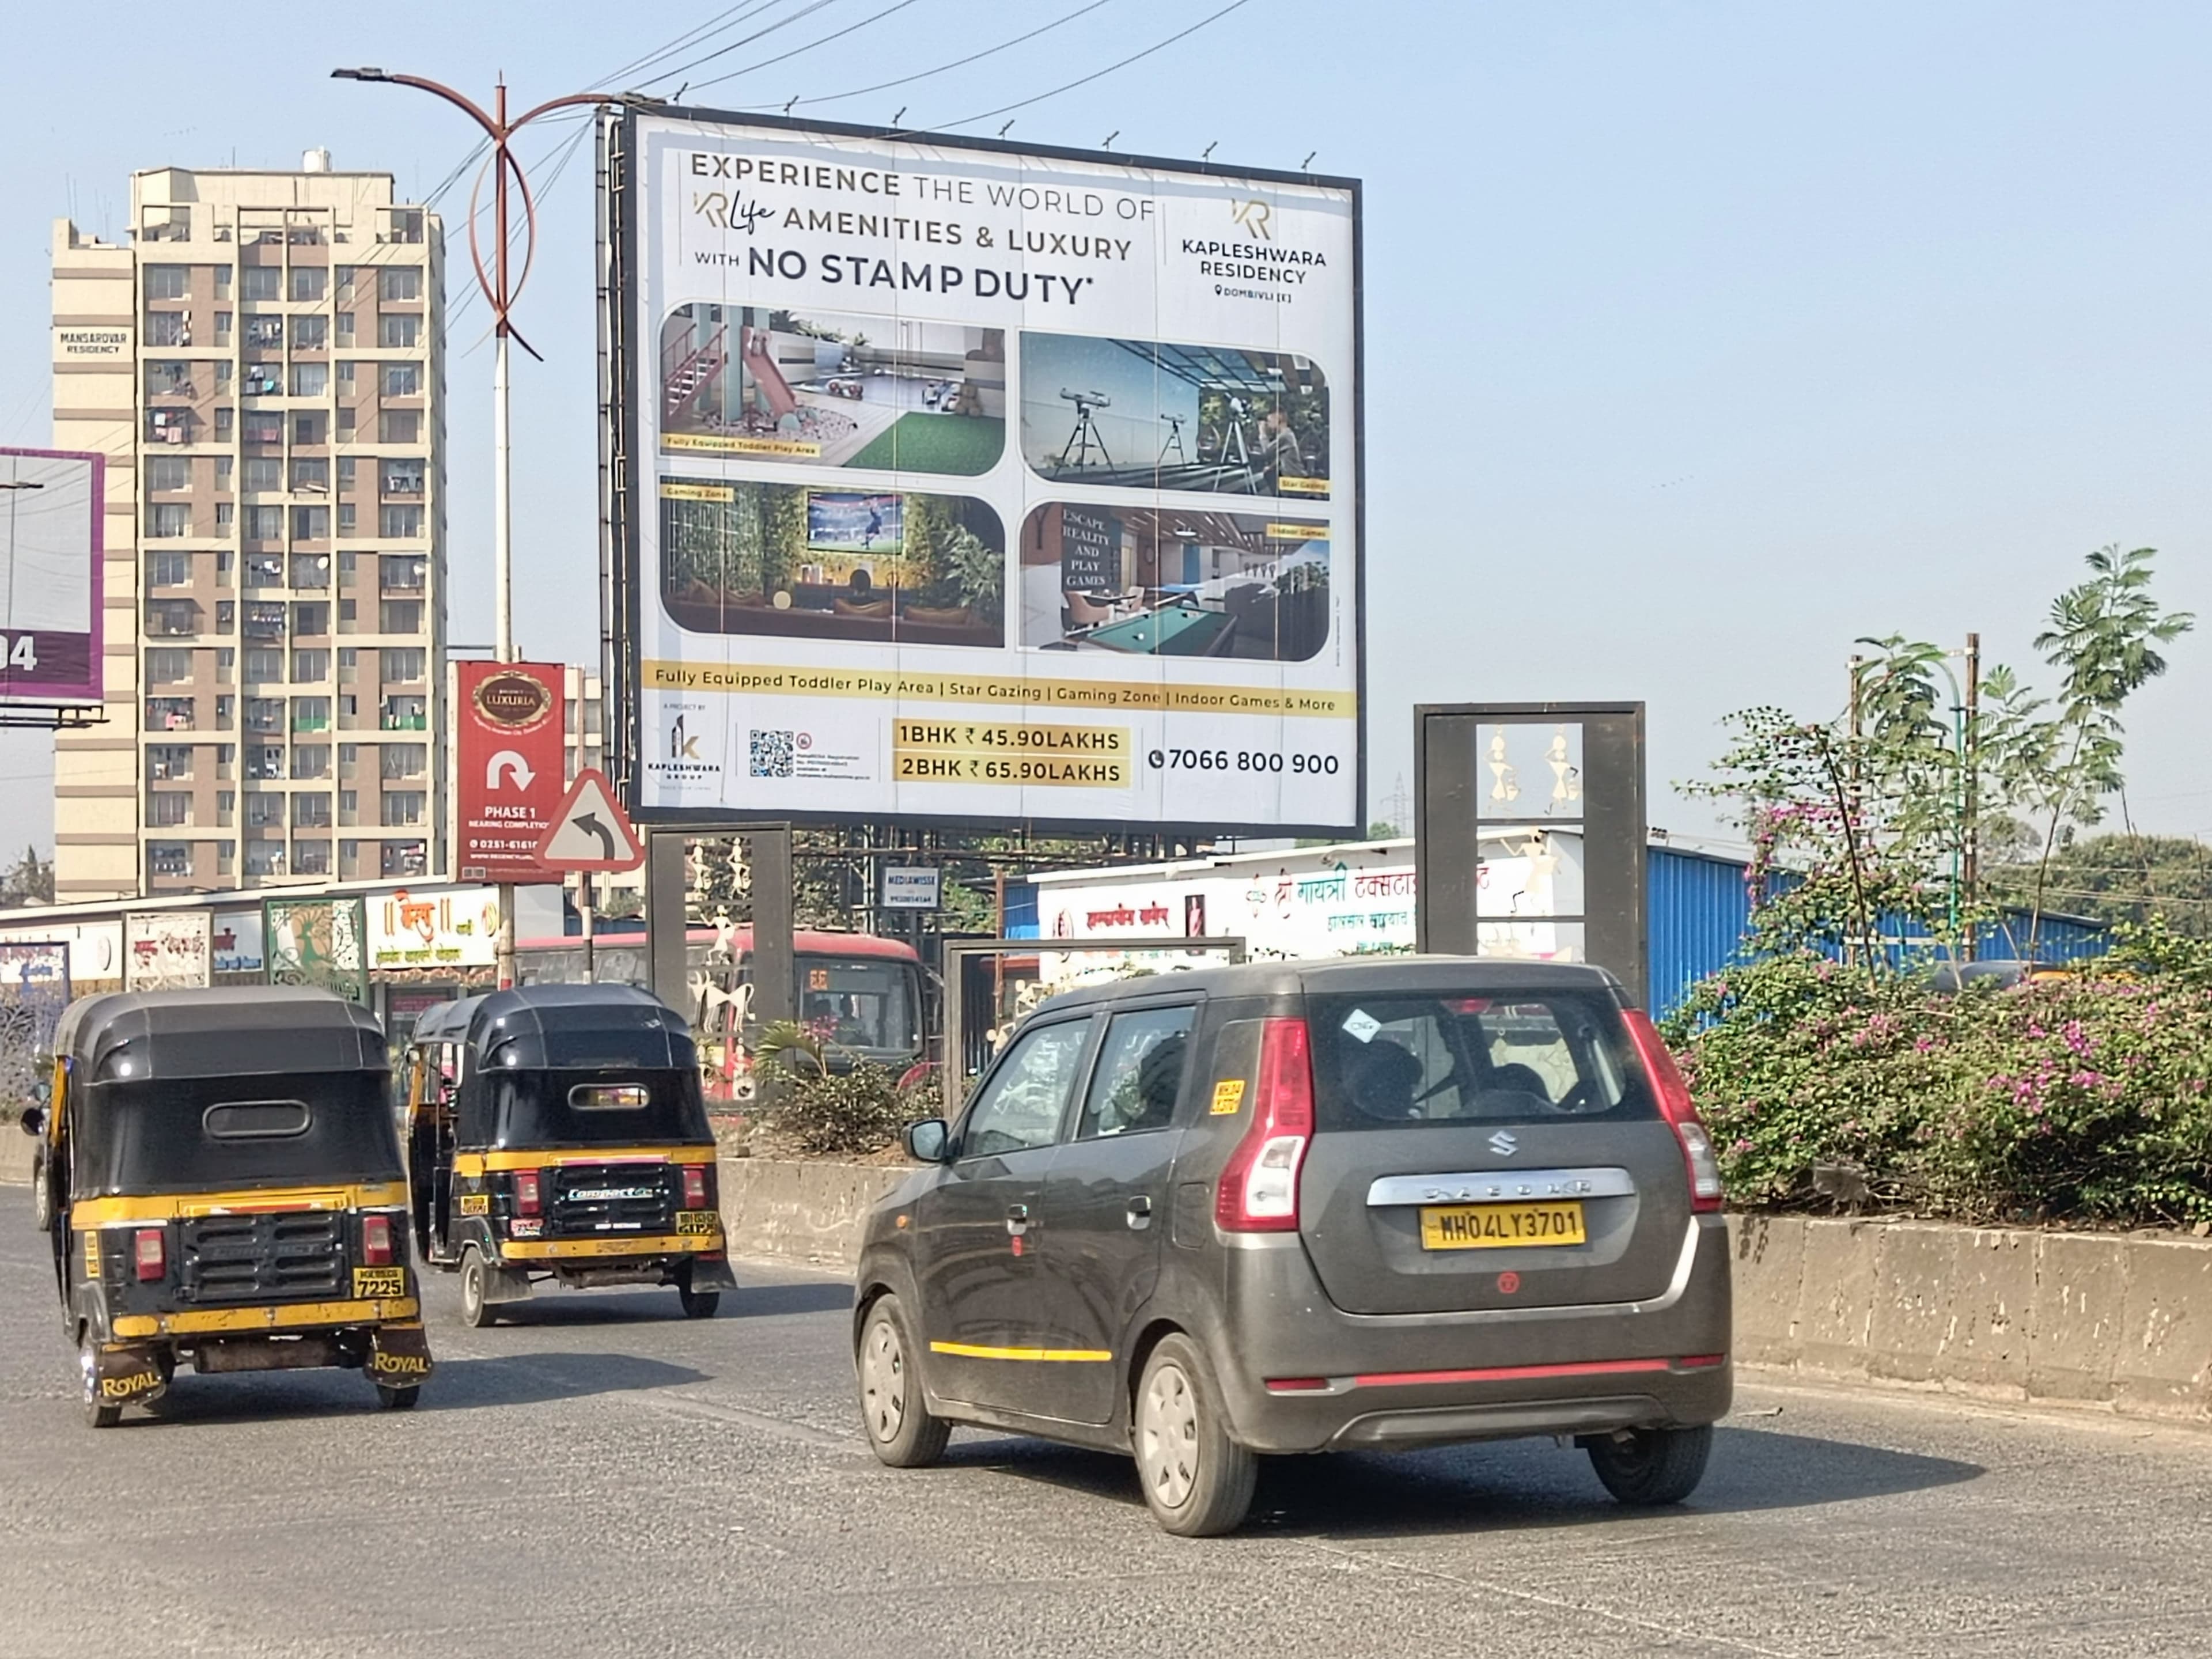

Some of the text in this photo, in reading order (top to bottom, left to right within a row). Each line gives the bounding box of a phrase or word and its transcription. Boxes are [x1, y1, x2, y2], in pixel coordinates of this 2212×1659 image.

[691, 153, 1154, 221] EXPERIENCE THE WORLD OF
[730, 190, 776, 236] Life
[783, 207, 962, 245] AMENITIES
[976, 225, 994, 248] &
[1008, 229, 1132, 261] LUXURY
[1181, 238, 1327, 267] KAPLESHWARA
[695, 251, 739, 267] WITH
[749, 247, 807, 280] NO
[821, 254, 963, 294] STAMP
[1200, 260, 1306, 285] RESIDENCY
[1224, 287, 1274, 301] DOMBIVLI
[60, 333, 127, 344] MANSAROVAR
[67, 346, 120, 354] RESIDENCY
[1063, 509, 1105, 531] ESCAPE
[1063, 525, 1110, 546] REALITY
[1075, 545, 1099, 558] AND
[1071, 559, 1100, 571] PLAY
[1066, 575, 1105, 586] GAMES
[486, 695, 535, 706] LUXURIA
[656, 669, 696, 685] Fully
[702, 671, 783, 690] Equipped
[789, 675, 852, 691] Toddler
[858, 677, 892, 695] Play
[897, 680, 934, 695] Area
[950, 681, 981, 696] Star
[987, 684, 1041, 702] Gazing
[1056, 687, 1116, 704] Gaming
[1123, 689, 1161, 703] Zone
[1176, 692, 1225, 706] Indoor
[1230, 694, 1280, 709] Games
[1285, 696, 1294, 709] &
[1300, 698, 1335, 712] More
[900, 725, 957, 744] 1BHK
[965, 726, 976, 745] ₹
[902, 758, 961, 777] 2BHK
[969, 759, 981, 778] ₹
[1169, 749, 1339, 775] 7066 800 900
[485, 806, 536, 819] PHASE 1
[1297, 861, 1347, 904] गायत्री
[1440, 1210, 1578, 1241] MH04LY3701
[357, 1279, 402, 1297] 7225
[374, 1351, 427, 1374] ROYAL
[101, 1370, 160, 1397] ROYAL
